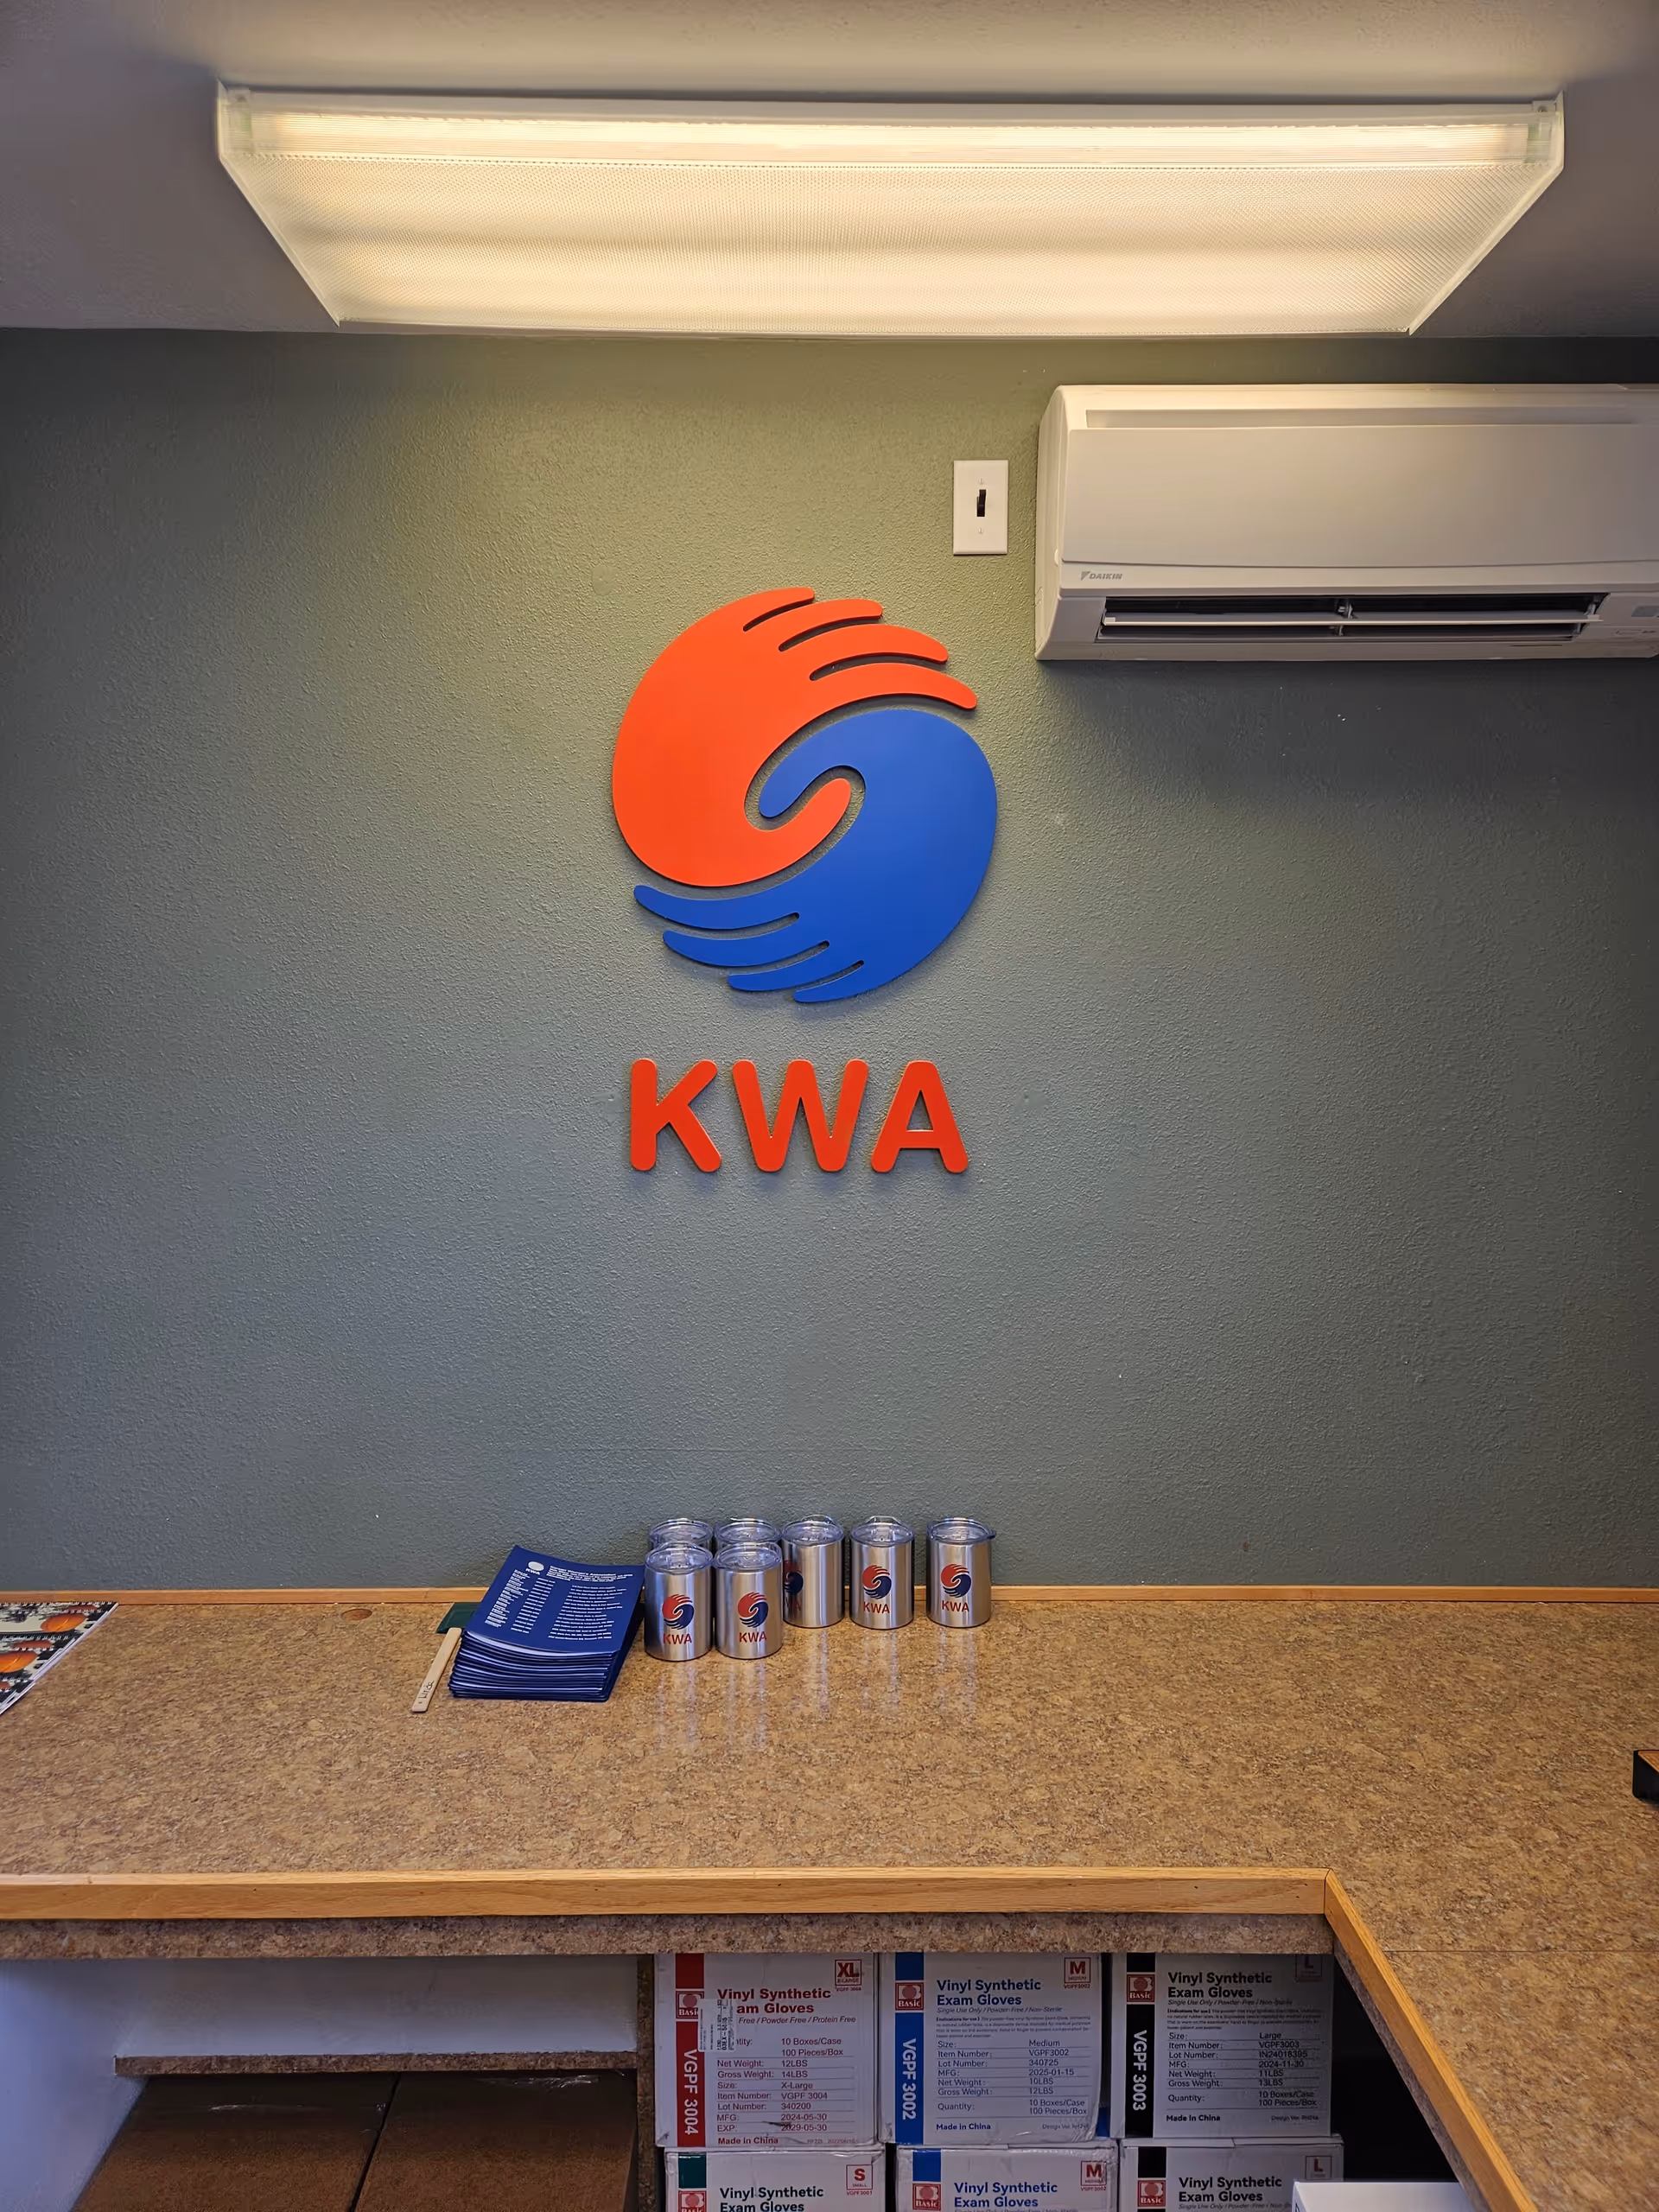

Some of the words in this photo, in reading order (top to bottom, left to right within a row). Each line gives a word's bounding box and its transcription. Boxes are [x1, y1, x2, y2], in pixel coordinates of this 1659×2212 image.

[631, 1058, 969, 1173] KWA
[864, 1601, 890, 1614] KWA
[942, 1599, 969, 1612] KWA
[663, 1633, 692, 1645] KWA
[739, 1630, 767, 1643] KWA
[837, 1961, 860, 1978] XL
[1070, 1961, 1086, 1974] M
[1167, 1972, 1203, 1986] Vinyl
[1206, 1971, 1273, 1985] Synthetic
[936, 1979, 971, 1993] Vinyl
[975, 1978, 1042, 1993] Synthetic
[717, 1988, 755, 2002] Vinyl
[759, 1987, 831, 2003] Synthetic
[1167, 1986, 1205, 1999] Exam
[1208, 1986, 1253, 1999] Gloves
[937, 1994, 973, 2005] Exam
[976, 1993, 1022, 2005] Gloves
[736, 2004, 760, 2014] am
[764, 2002, 815, 2014] Gloves
[793, 2037, 842, 2046] Boxes/Case
[938, 2040, 957, 2049] Size:
[1028, 2038, 1061, 2047] Medium
[798, 2048, 843, 2057] Pieces/Box
[956, 2050, 993, 2058] Number:
[1028, 2049, 1070, 2057] VGPF3002
[1133, 2030, 1147, 2071] VGPF
[717, 2059, 733, 2068] Net
[734, 2059, 764, 2069] Weight:
[902, 2037, 917, 2080] VGPF
[953, 2059, 988, 2068] Number:
[1028, 2058, 1059, 2067] 340725
[683, 2049, 698, 2094] VGPF
[717, 2070, 742, 2079] Gross
[743, 2069, 774, 2079] Weight:
[938, 2069, 960, 2077] MFG:
[1028, 2068, 1075, 2076] 2025-01-15
[1184, 2070, 1216, 2079] Weight:
[717, 2081, 737, 2089] Size:
[780, 2081, 813, 2091] X-Large
[938, 2078, 953, 2087] Net
[954, 2078, 986, 2088] Weight:
[1029, 2077, 1054, 2086] 10LBS
[1192, 2079, 1224, 2088] Weight:
[717, 2092, 736, 2101] Item
[737, 2091, 772, 2100] Number:
[780, 2092, 806, 2101] VGPF
[938, 2088, 960, 2096] Gross
[961, 2088, 993, 2097] Weight:
[1133, 2075, 1147, 2111] 3003
[1168, 2094, 1205, 2103] Quantity:
[717, 2102, 730, 2111] Lot
[732, 2102, 767, 2111] Number:
[780, 2102, 811, 2111] 340200
[902, 2082, 917, 2120] 3002
[938, 2102, 976, 2112] Quantity:
[1039, 2098, 1085, 2107] Boxes/Case
[683, 2099, 699, 2135] 3004
[717, 2113, 740, 2122] MFG:
[780, 2113, 828, 2121] 2024-05-30
[1029, 2107, 1043, 2115] 100
[1045, 2107, 1088, 2116] Pieces/Box
[1198, 2113, 1221, 2122] China
[717, 2124, 737, 2133] EXP:
[780, 2123, 828, 2132] 2029-05-30
[717, 2136, 741, 2145] Made
[753, 2136, 779, 2145] China
[1086, 2164, 1103, 2178] M
[1313, 2158, 1324, 2172] L
[855, 2168, 866, 2181] S
[954, 2182, 988, 2196] Vinyl
[992, 2182, 1058, 2196] Synthetic
[1179, 2177, 1214, 2191] Vinyl
[1217, 2176, 1282, 2190] Synthetic
[719, 2187, 754, 2202] Vinyl
[758, 2186, 824, 2199] Synthetic
[1179, 2191, 1215, 2202] Exam
[1218, 2190, 1263, 2202] Gloves
[720, 2202, 756, 2212] Exam
[760, 2201, 804, 2212] Gloves
[954, 2196, 990, 2208] Exam
[994, 2196, 1039, 2208] Gloves
